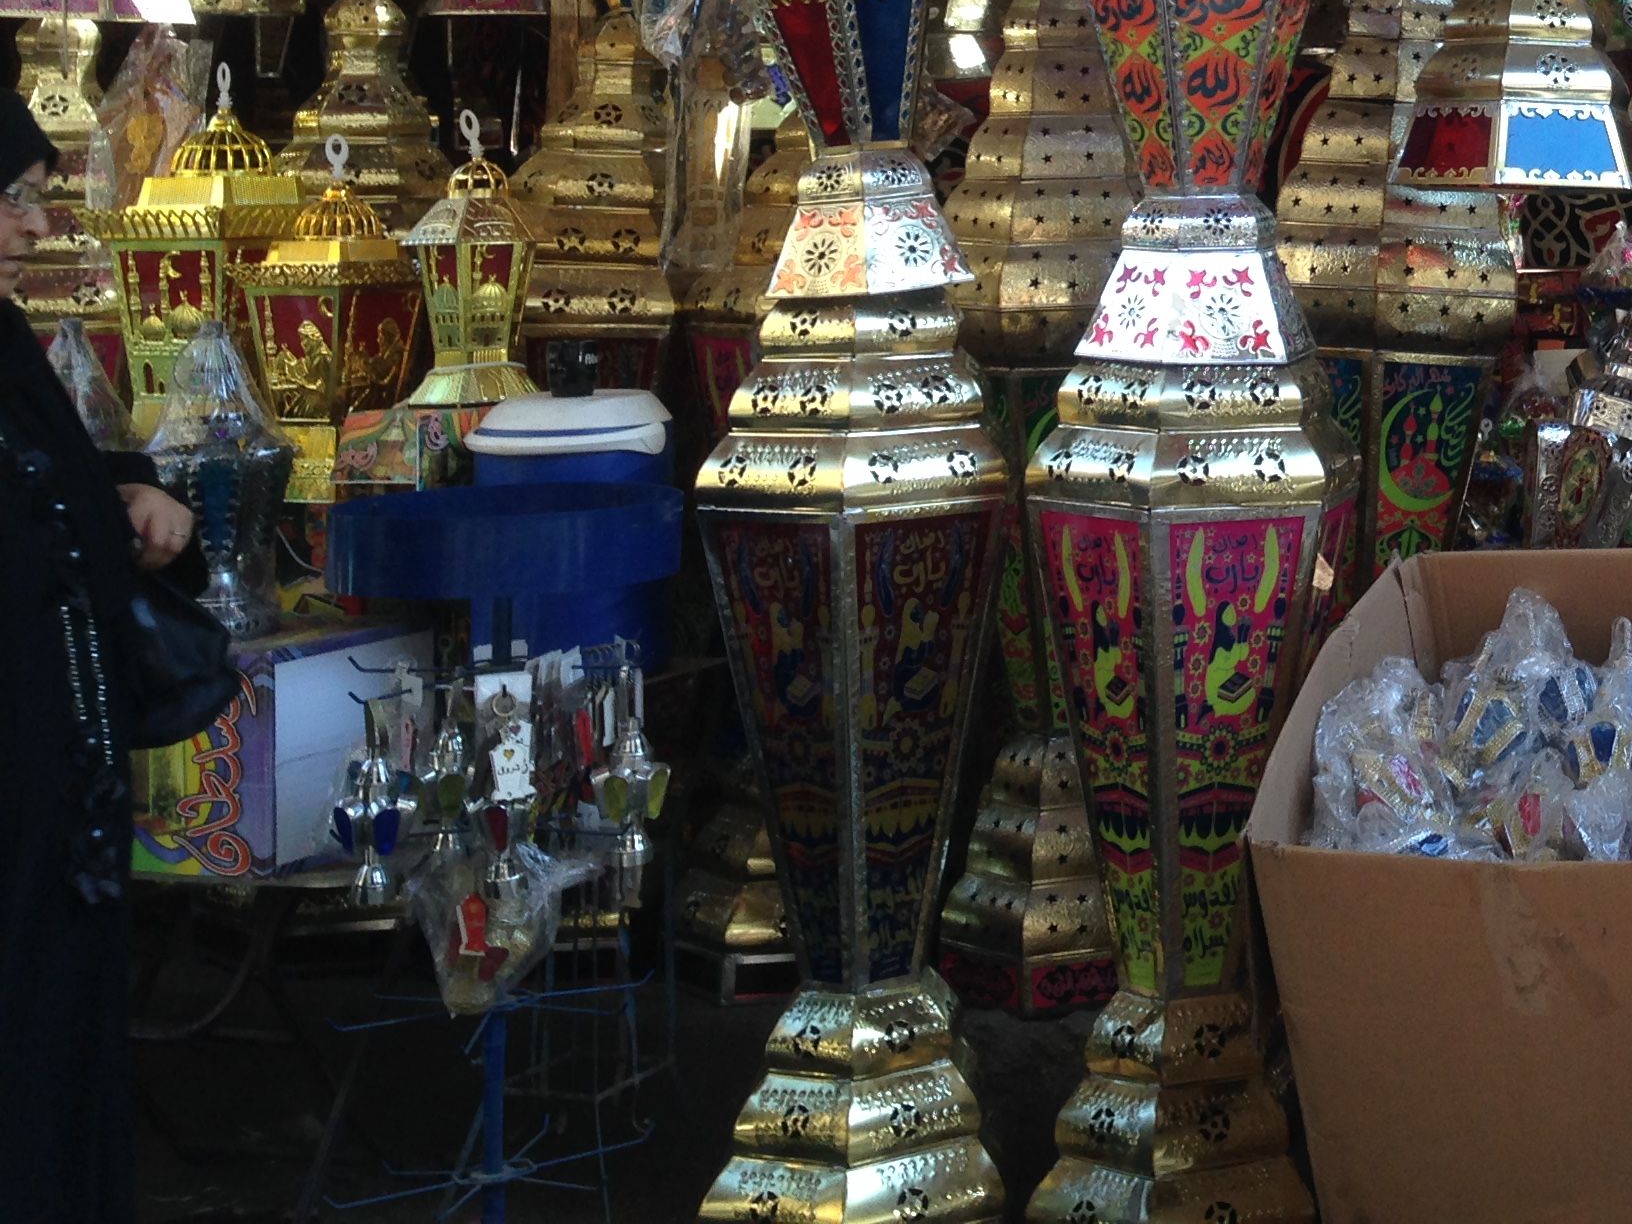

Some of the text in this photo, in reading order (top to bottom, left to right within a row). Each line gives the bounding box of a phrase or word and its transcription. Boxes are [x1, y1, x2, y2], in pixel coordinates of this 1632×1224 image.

[1122, 63, 1163, 115] الله
[1186, 55, 1241, 109] الله
[893, 546, 947, 594] يارب
[1205, 553, 1260, 595] يارب
